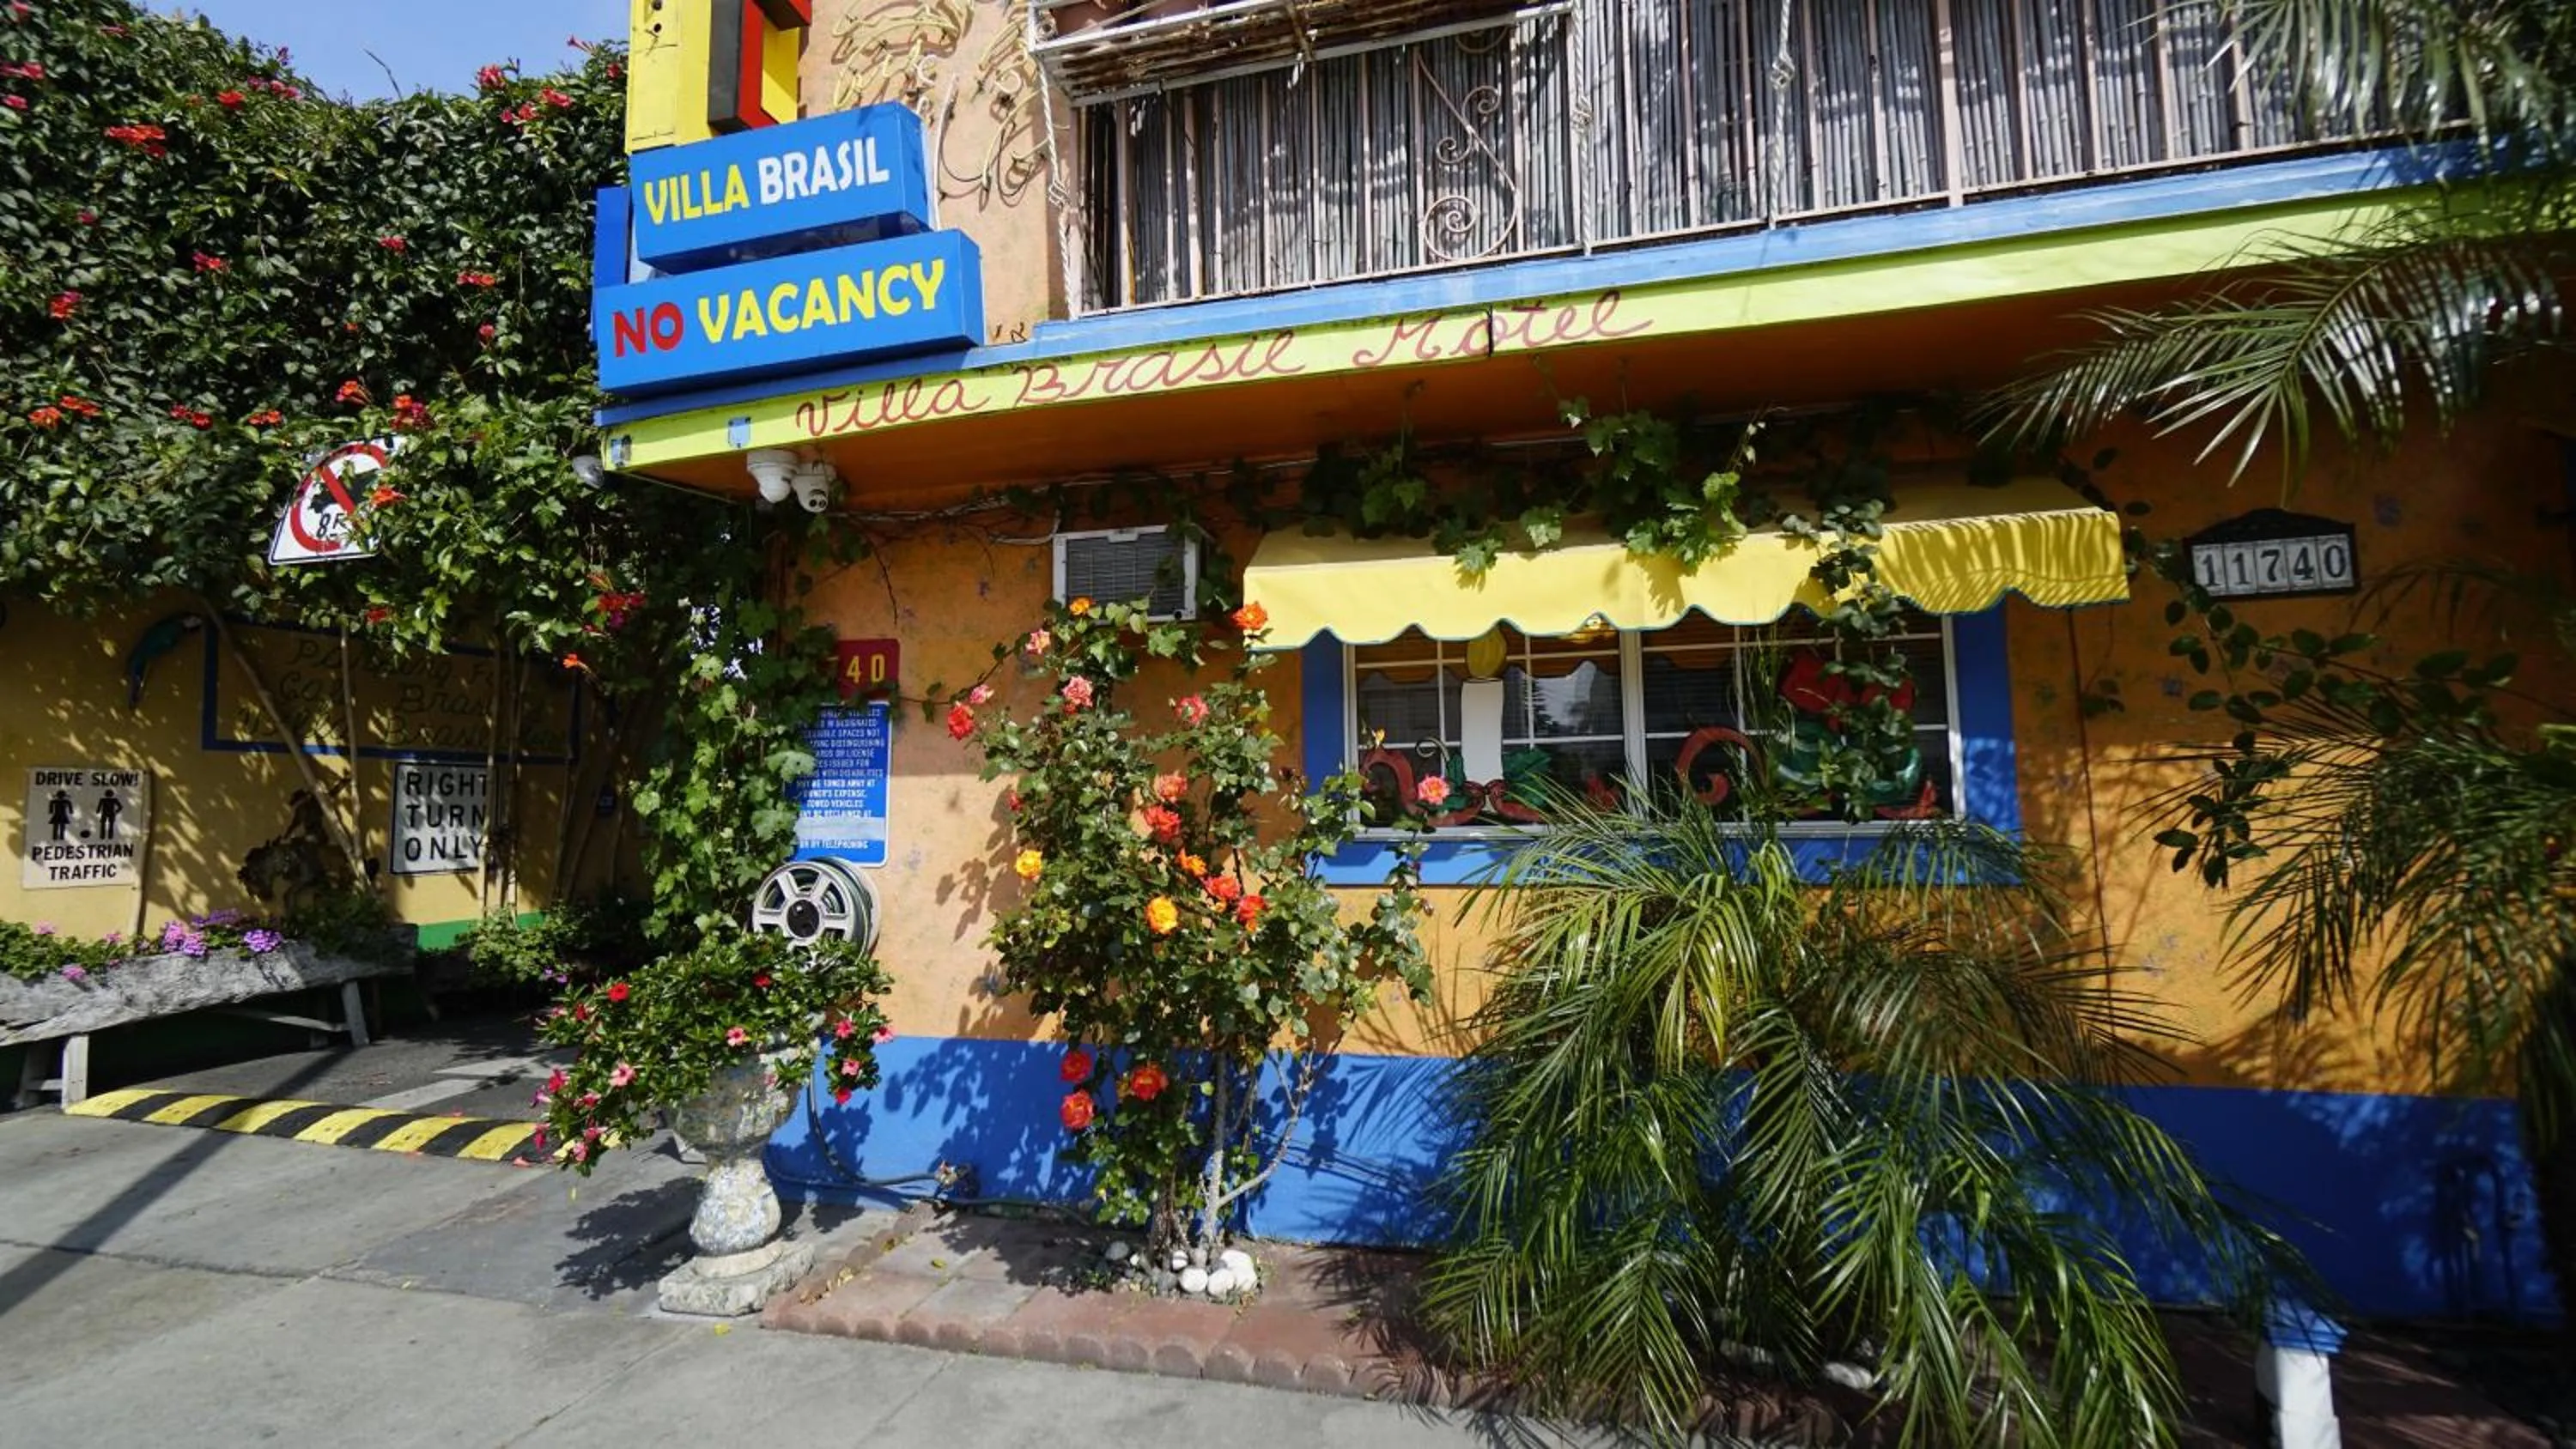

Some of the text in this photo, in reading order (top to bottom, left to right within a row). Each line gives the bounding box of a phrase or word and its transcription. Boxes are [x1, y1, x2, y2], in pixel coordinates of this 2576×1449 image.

[644, 136, 890, 226] VILLA BRASIL
[612, 258, 945, 358] NO VACANCY
[795, 289, 1653, 437] Villa Brasil Motel
[2202, 545, 2347, 587] 11740
[35, 772, 138, 787] DRIVE SLOW!
[405, 771, 488, 797] RIGHT
[405, 804, 487, 828] TURN
[32, 844, 135, 862] PEDESTRIAN
[404, 835, 486, 862] ONLY
[48, 864, 117, 881] TRAFFIC
